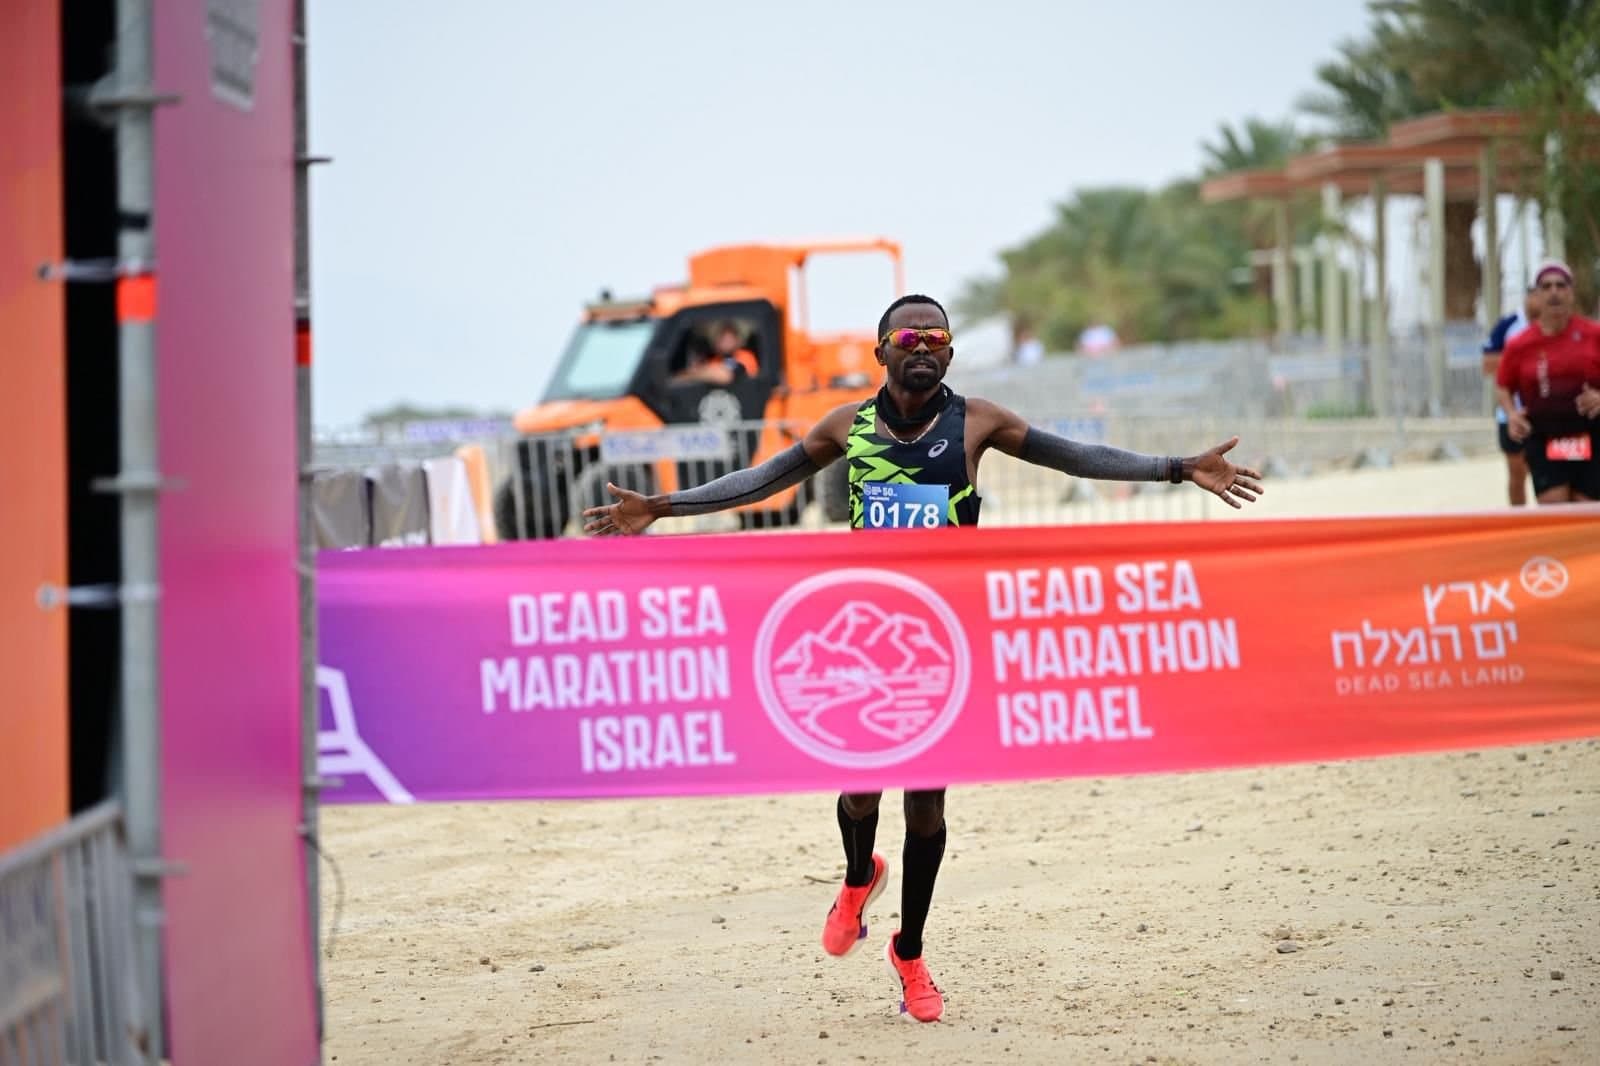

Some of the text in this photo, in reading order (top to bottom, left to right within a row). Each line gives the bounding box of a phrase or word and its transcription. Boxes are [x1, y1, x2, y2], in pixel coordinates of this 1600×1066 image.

[870, 501, 940, 529] 0178
[509, 585, 728, 646] DEAD SEA
[985, 559, 1203, 620] DEAD SEA
[1423, 578, 1516, 624] ארץ
[991, 618, 1241, 683] MARATHON
[1331, 619, 1519, 669] ים המלח
[480, 645, 731, 713] MARATHON
[1335, 664, 1525, 695] DEAD SEA LAND
[579, 710, 737, 773] ISRAEL
[997, 684, 1155, 747] ISRAEL
